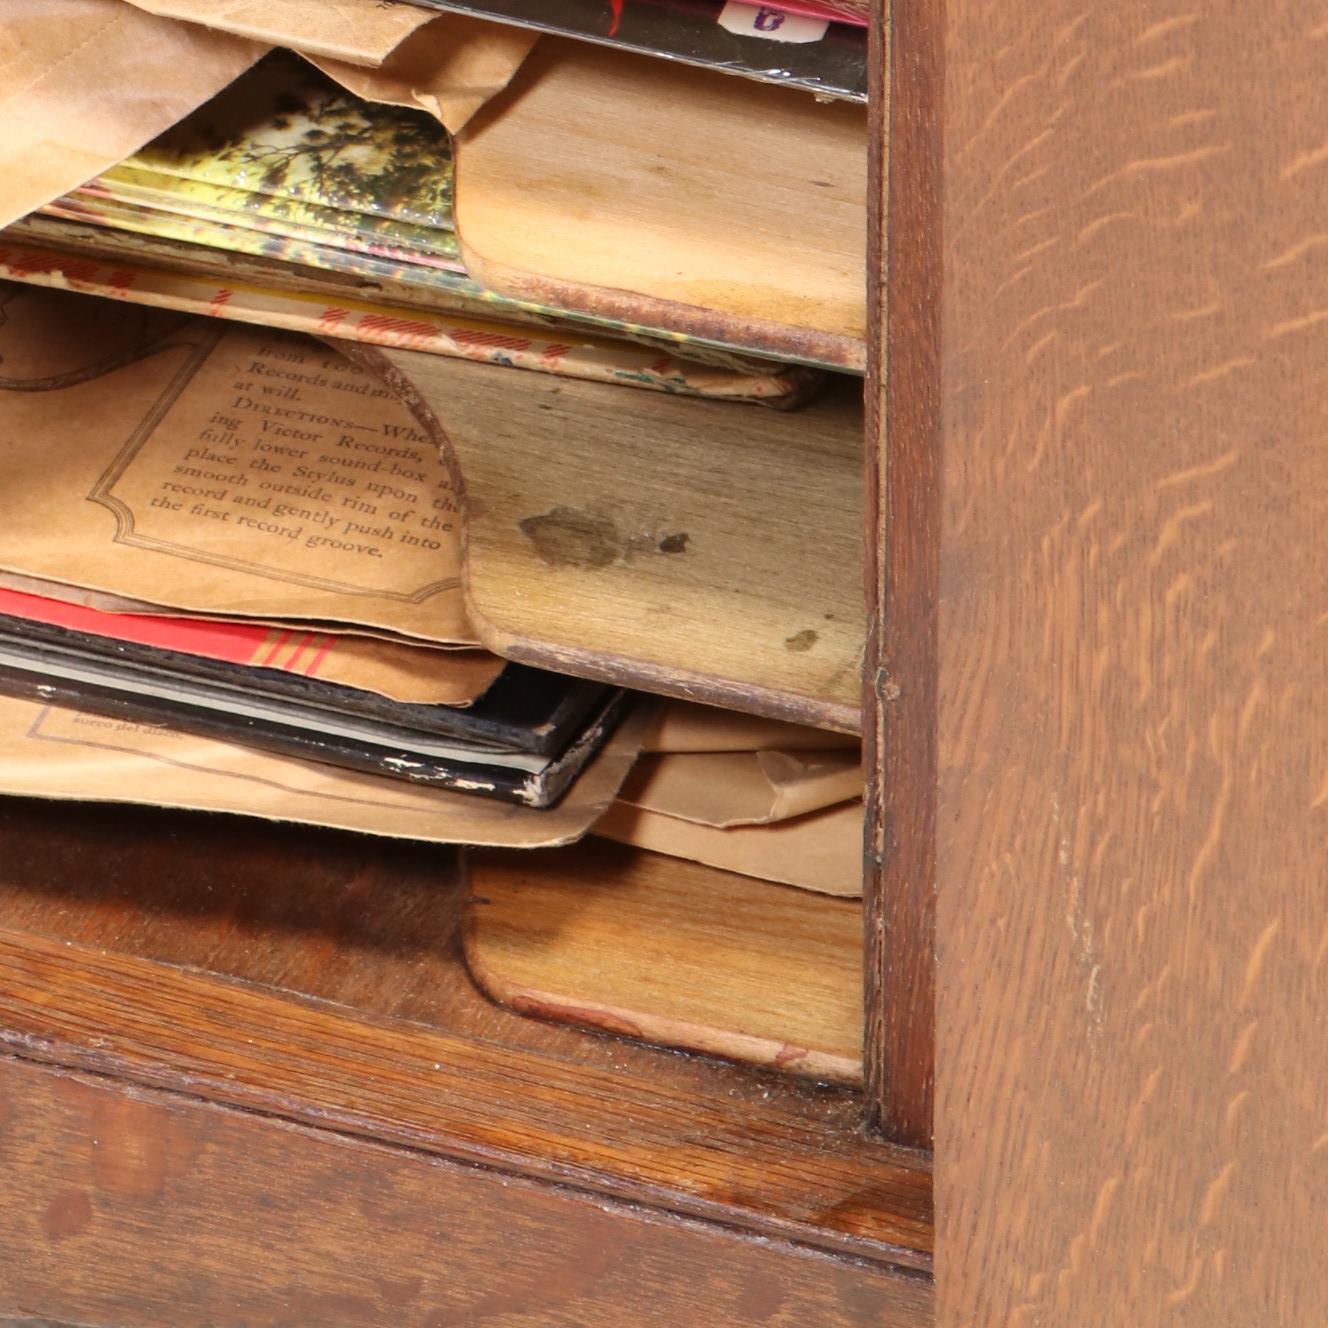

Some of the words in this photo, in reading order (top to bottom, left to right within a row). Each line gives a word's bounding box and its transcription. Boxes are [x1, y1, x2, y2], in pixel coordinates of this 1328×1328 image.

[247, 361, 328, 387] Records
[331, 381, 370, 395] and
[256, 346, 305, 365] from
[232, 380, 254, 391] at
[260, 384, 302, 401] will.
[197, 428, 246, 450] fully
[252, 438, 310, 460] lower
[319, 454, 429, 483] sound-box
[208, 411, 244, 432] ing
[260, 418, 324, 443] Victor
[337, 434, 423, 463] Records,
[173, 464, 250, 487] smooth
[258, 481, 334, 503] outside
[341, 495, 379, 515] rim
[388, 509, 417, 523] of
[421, 515, 455, 533] the
[183, 447, 239, 466] place
[249, 457, 283, 474] the
[292, 464, 357, 487] Stylus
[365, 482, 419, 505] upon
[149, 496, 184, 512] the
[189, 502, 233, 522] first
[236, 515, 304, 540] record
[305, 532, 384, 559] groove.
[161, 480, 229, 502] record
[231, 494, 273, 510] and
[272, 502, 340, 530] gently
[342, 520, 395, 541] push
[399, 530, 442, 551] into
